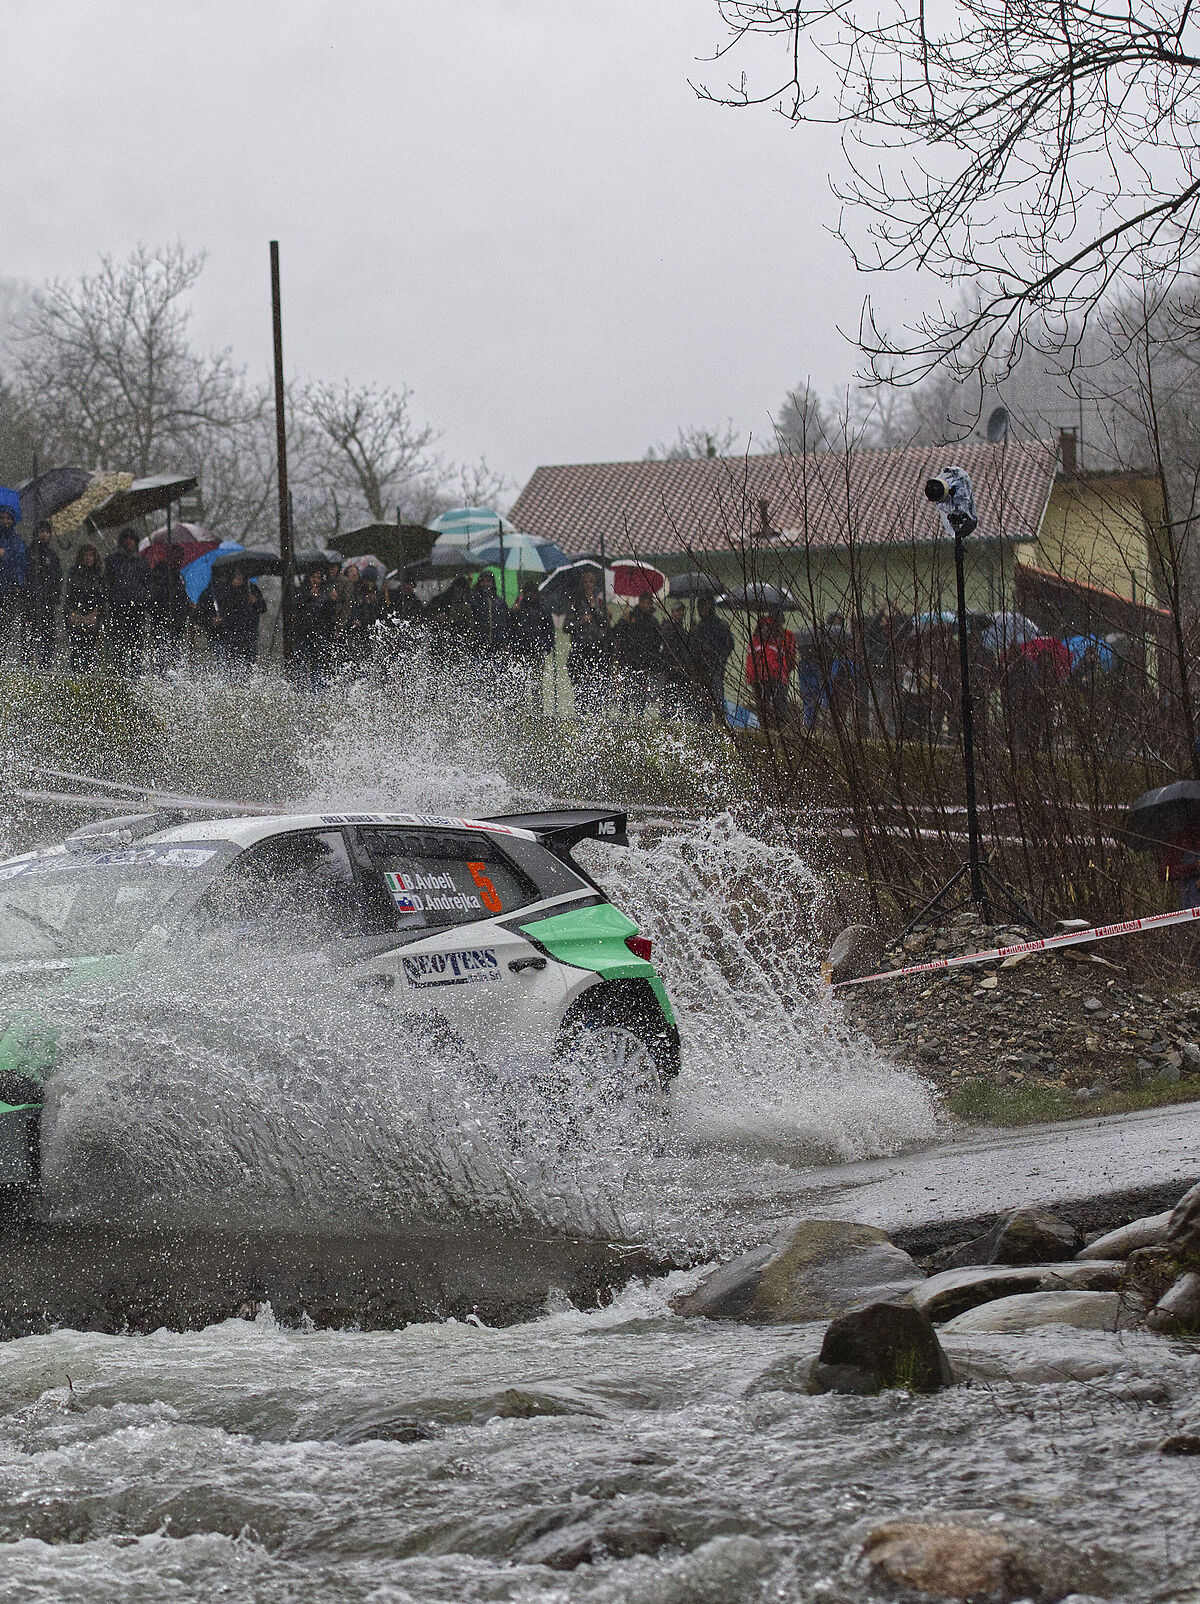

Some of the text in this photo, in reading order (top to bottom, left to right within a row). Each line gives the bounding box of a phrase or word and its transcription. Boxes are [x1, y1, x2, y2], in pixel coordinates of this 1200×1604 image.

[402, 872, 457, 892] B.Avbelj
[466, 862, 503, 912] 5
[412, 893, 481, 912] D.Andrejka
[402, 948, 498, 984] NEOTENS
